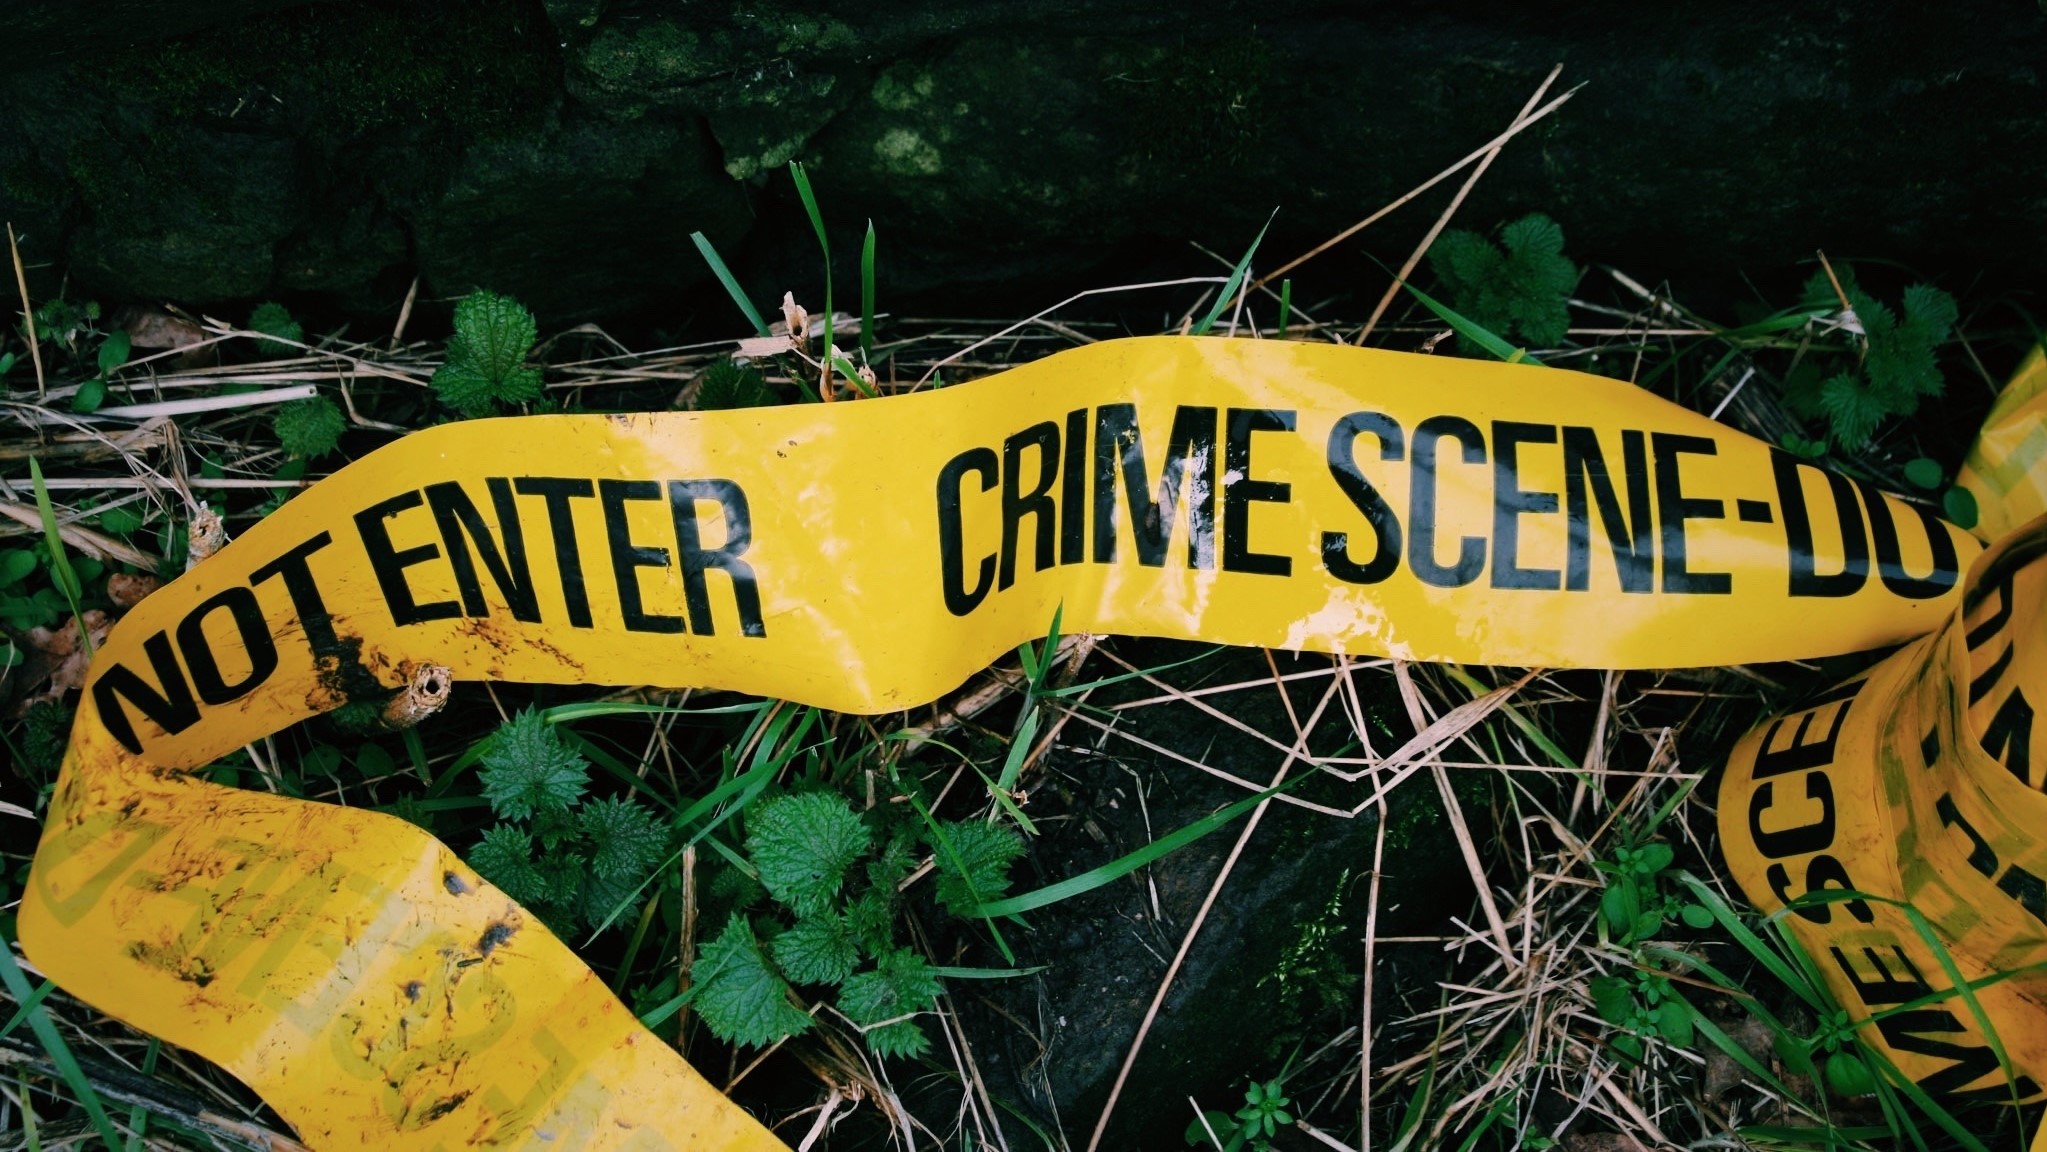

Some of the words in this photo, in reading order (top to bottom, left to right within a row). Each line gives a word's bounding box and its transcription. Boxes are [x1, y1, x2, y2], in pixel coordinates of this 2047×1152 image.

[92, 531, 332, 755] NOT
[353, 476, 767, 639] ENTER
[936, 402, 1298, 617] CRIME
